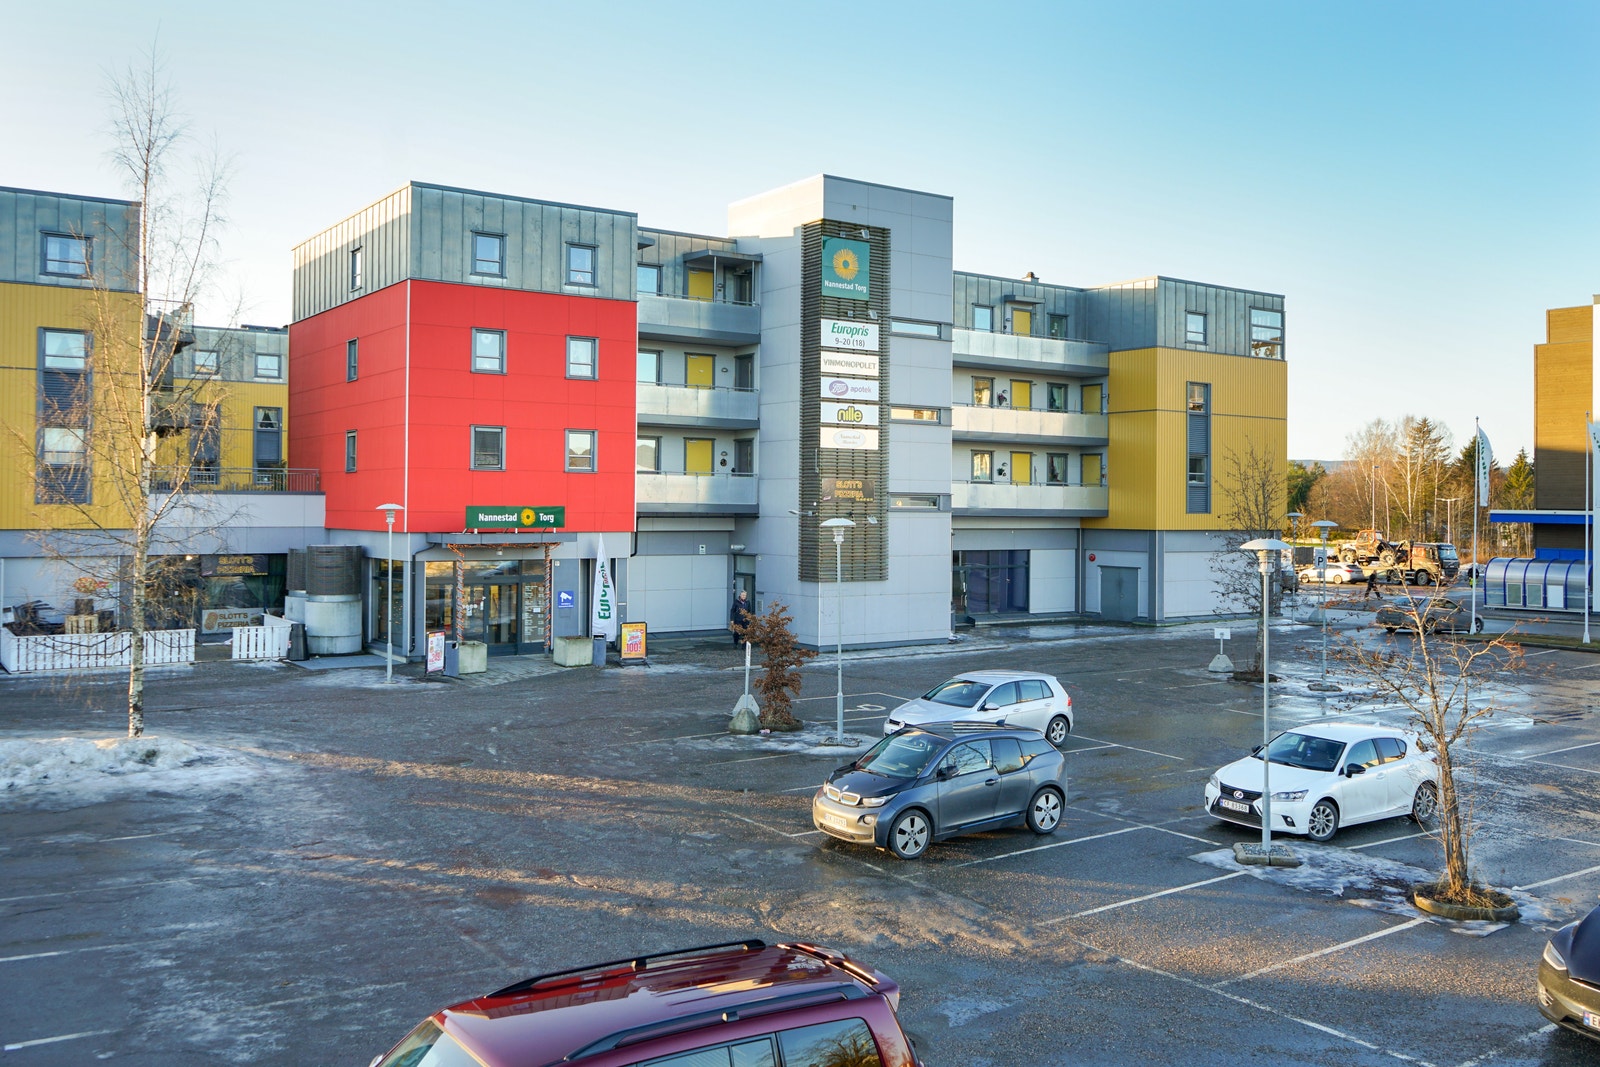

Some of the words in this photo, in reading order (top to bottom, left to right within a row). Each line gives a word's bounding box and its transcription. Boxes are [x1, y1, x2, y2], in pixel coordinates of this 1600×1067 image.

[824, 279, 854, 291] Nannestad
[855, 283, 867, 294] Torg
[831, 323, 869, 338] Europris
[835, 338, 850, 346] 9-20
[852, 338, 866, 348] (18)
[823, 358, 876, 370] VINMONOPOLET
[837, 405, 863, 423] nille
[478, 512, 517, 522] Nannestad
[539, 512, 555, 524] Torg
[1318, 556, 1324, 566] P
